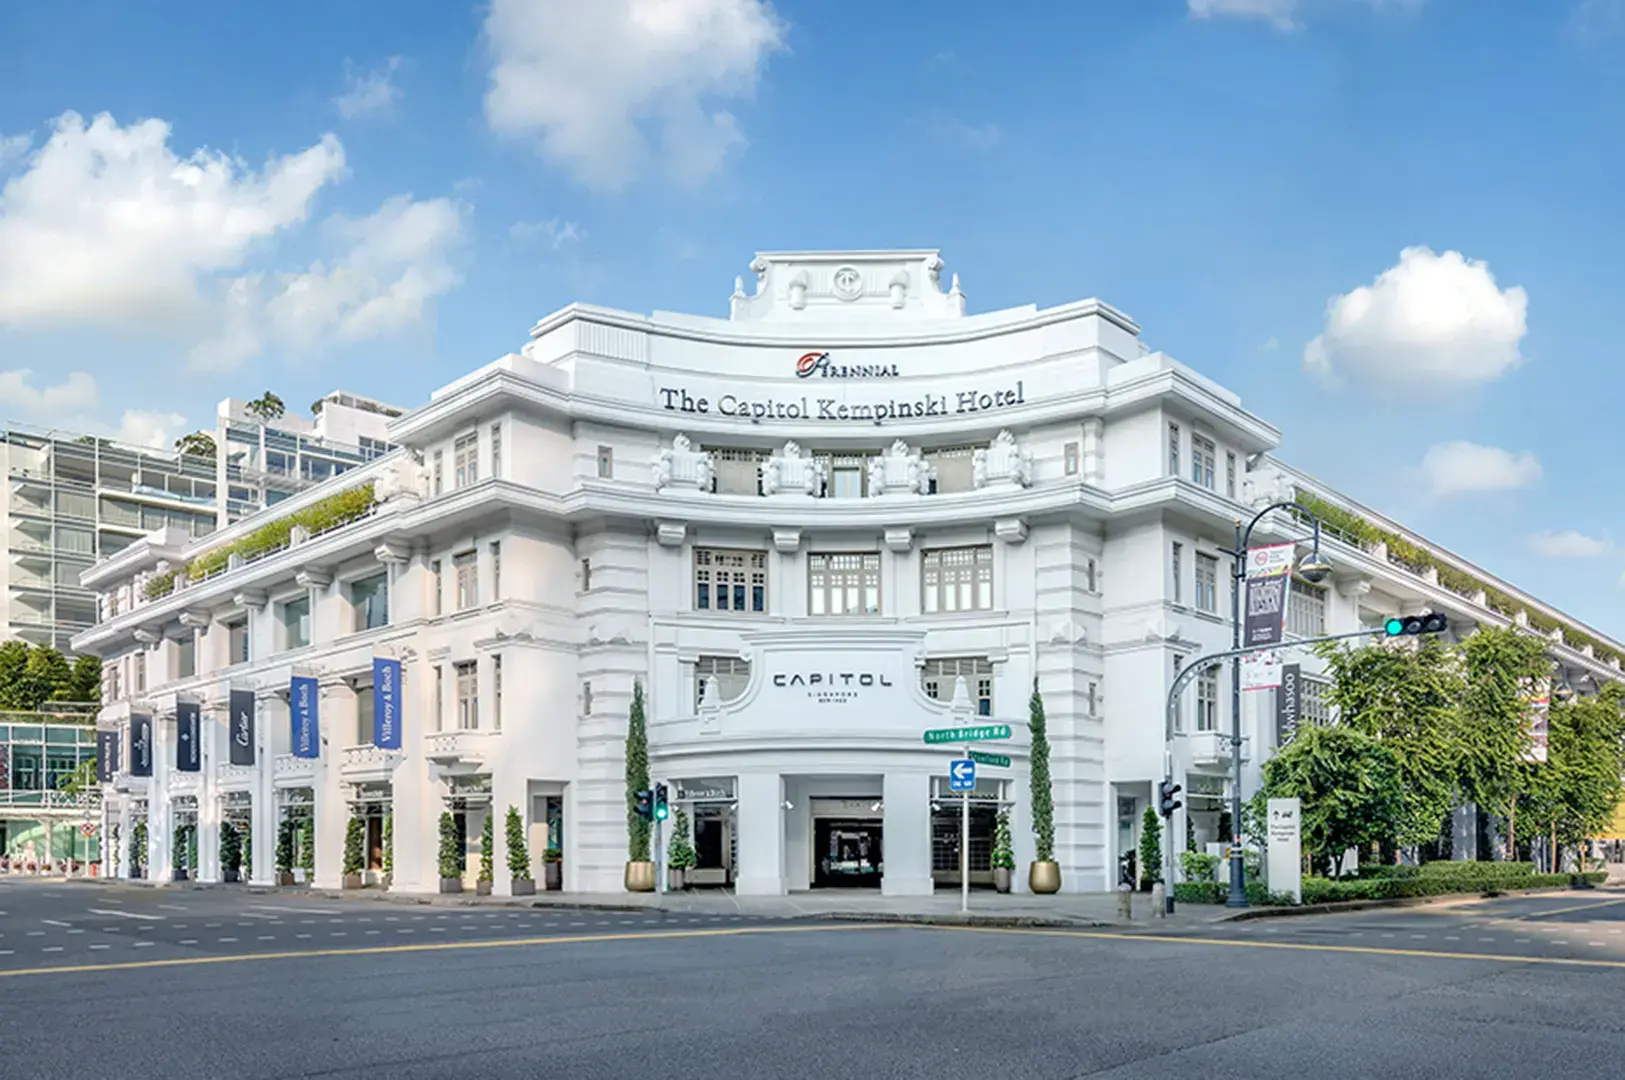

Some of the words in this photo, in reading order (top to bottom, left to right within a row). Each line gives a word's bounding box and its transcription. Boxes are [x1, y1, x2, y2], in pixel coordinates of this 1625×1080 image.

[659, 387, 709, 413] The
[717, 394, 810, 424] Capitol
[816, 393, 948, 426] Kempinski
[956, 380, 1025, 413] Hotel
[381, 666, 392, 692] Boch
[773, 673, 893, 687] CAPITOL
[298, 684, 308, 708] Boch
[235, 711, 249, 747] Cartier
[381, 703, 394, 742] Villeroy
[928, 731, 956, 740] North
[958, 729, 991, 739] Bridge
[993, 726, 1007, 736] Rd
